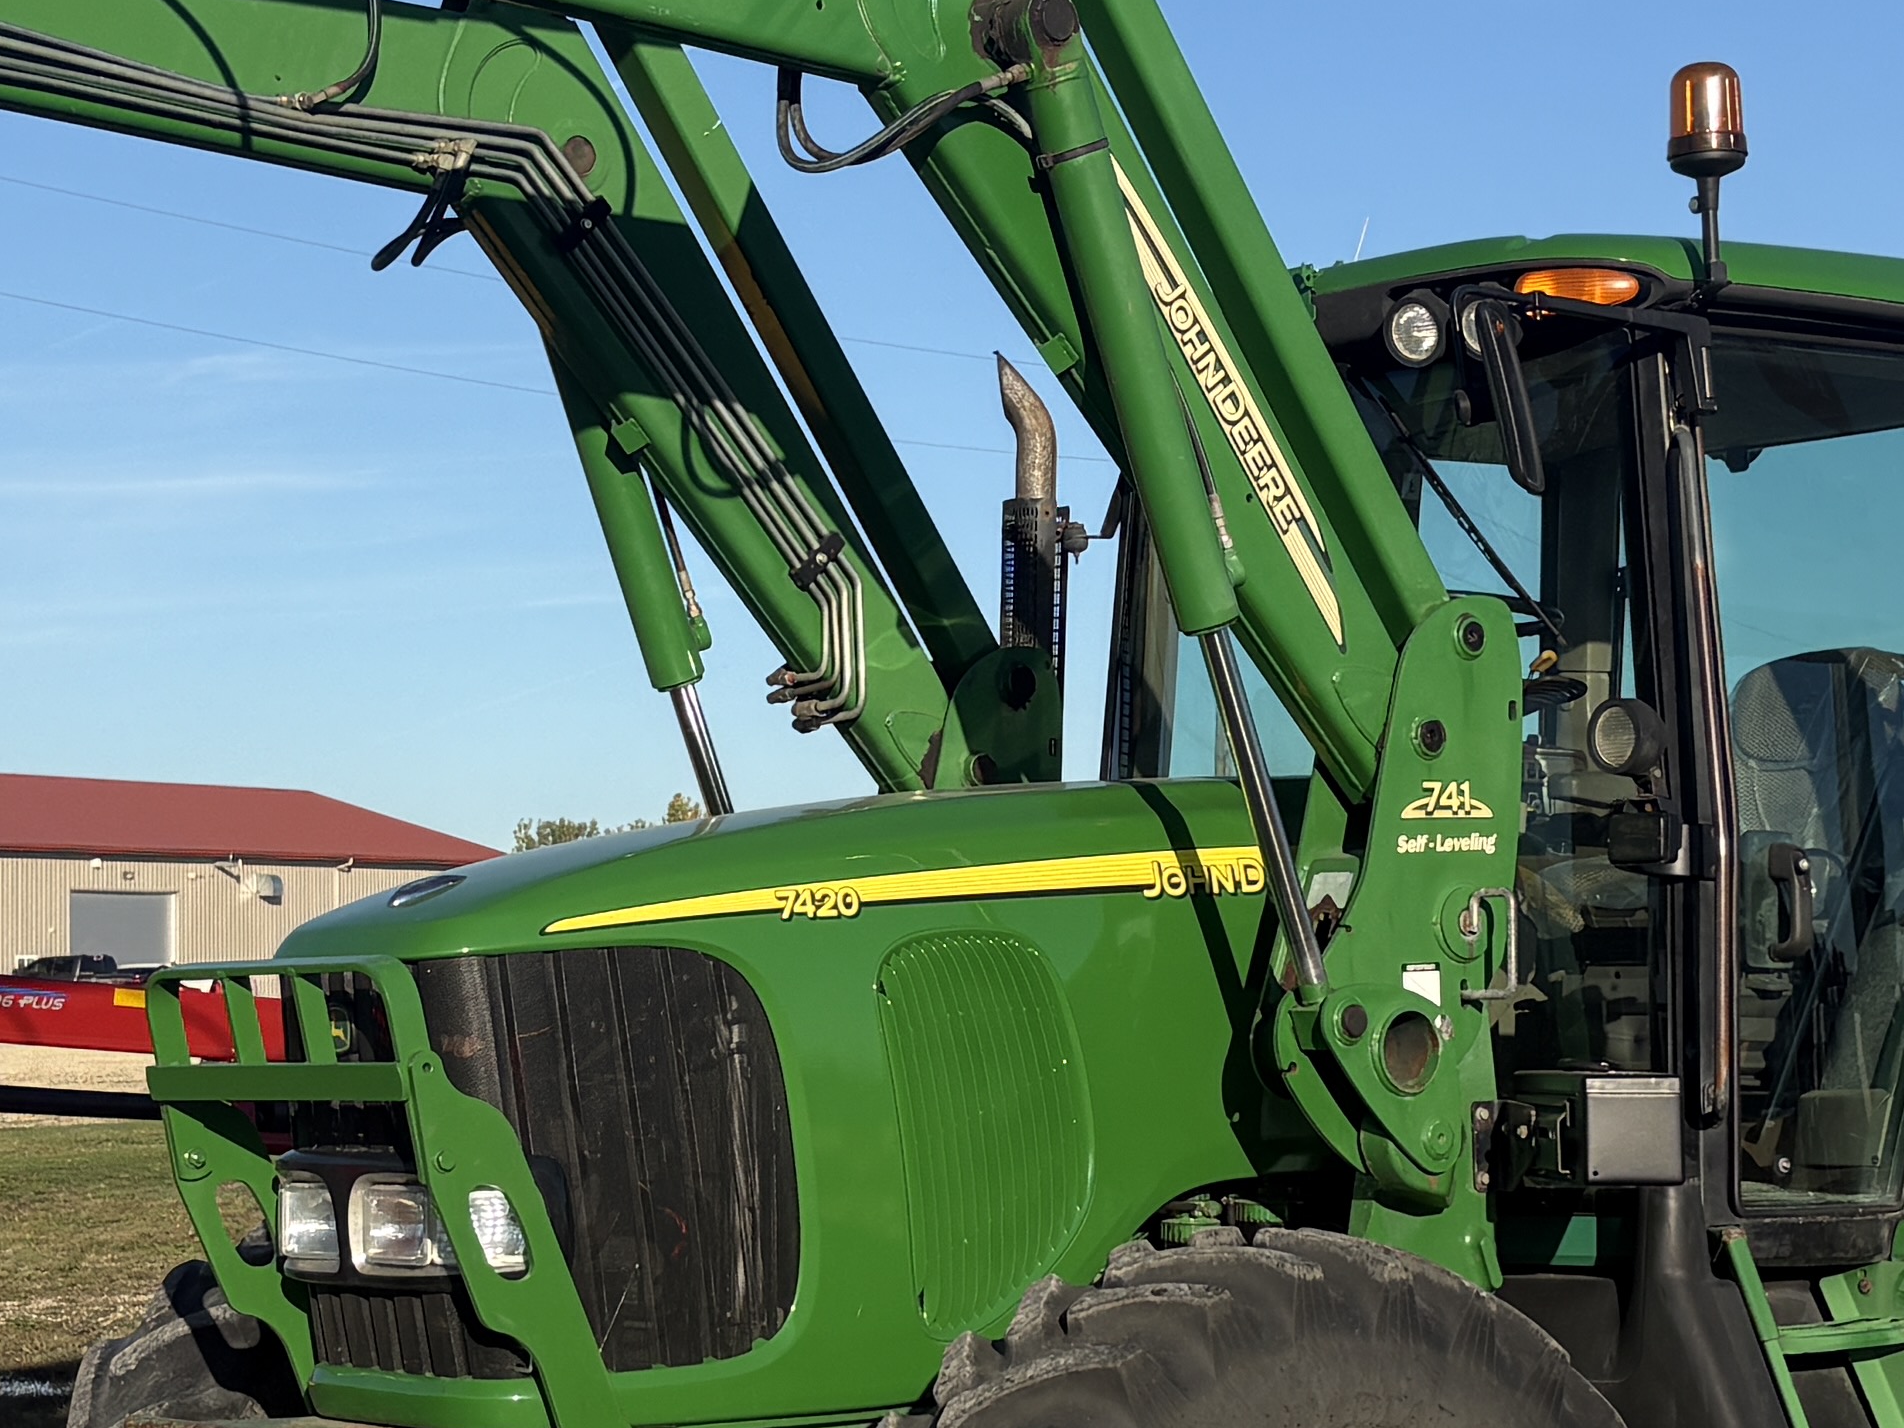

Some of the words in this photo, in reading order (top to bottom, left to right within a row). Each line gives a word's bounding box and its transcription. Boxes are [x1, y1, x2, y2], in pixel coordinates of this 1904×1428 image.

[1155, 281, 1226, 395] JOHN
[1214, 379, 1302, 536] DEERE
[1422, 779, 1471, 815] 741
[775, 886, 861, 919] 7420
[1143, 859, 1234, 898] JOHN
